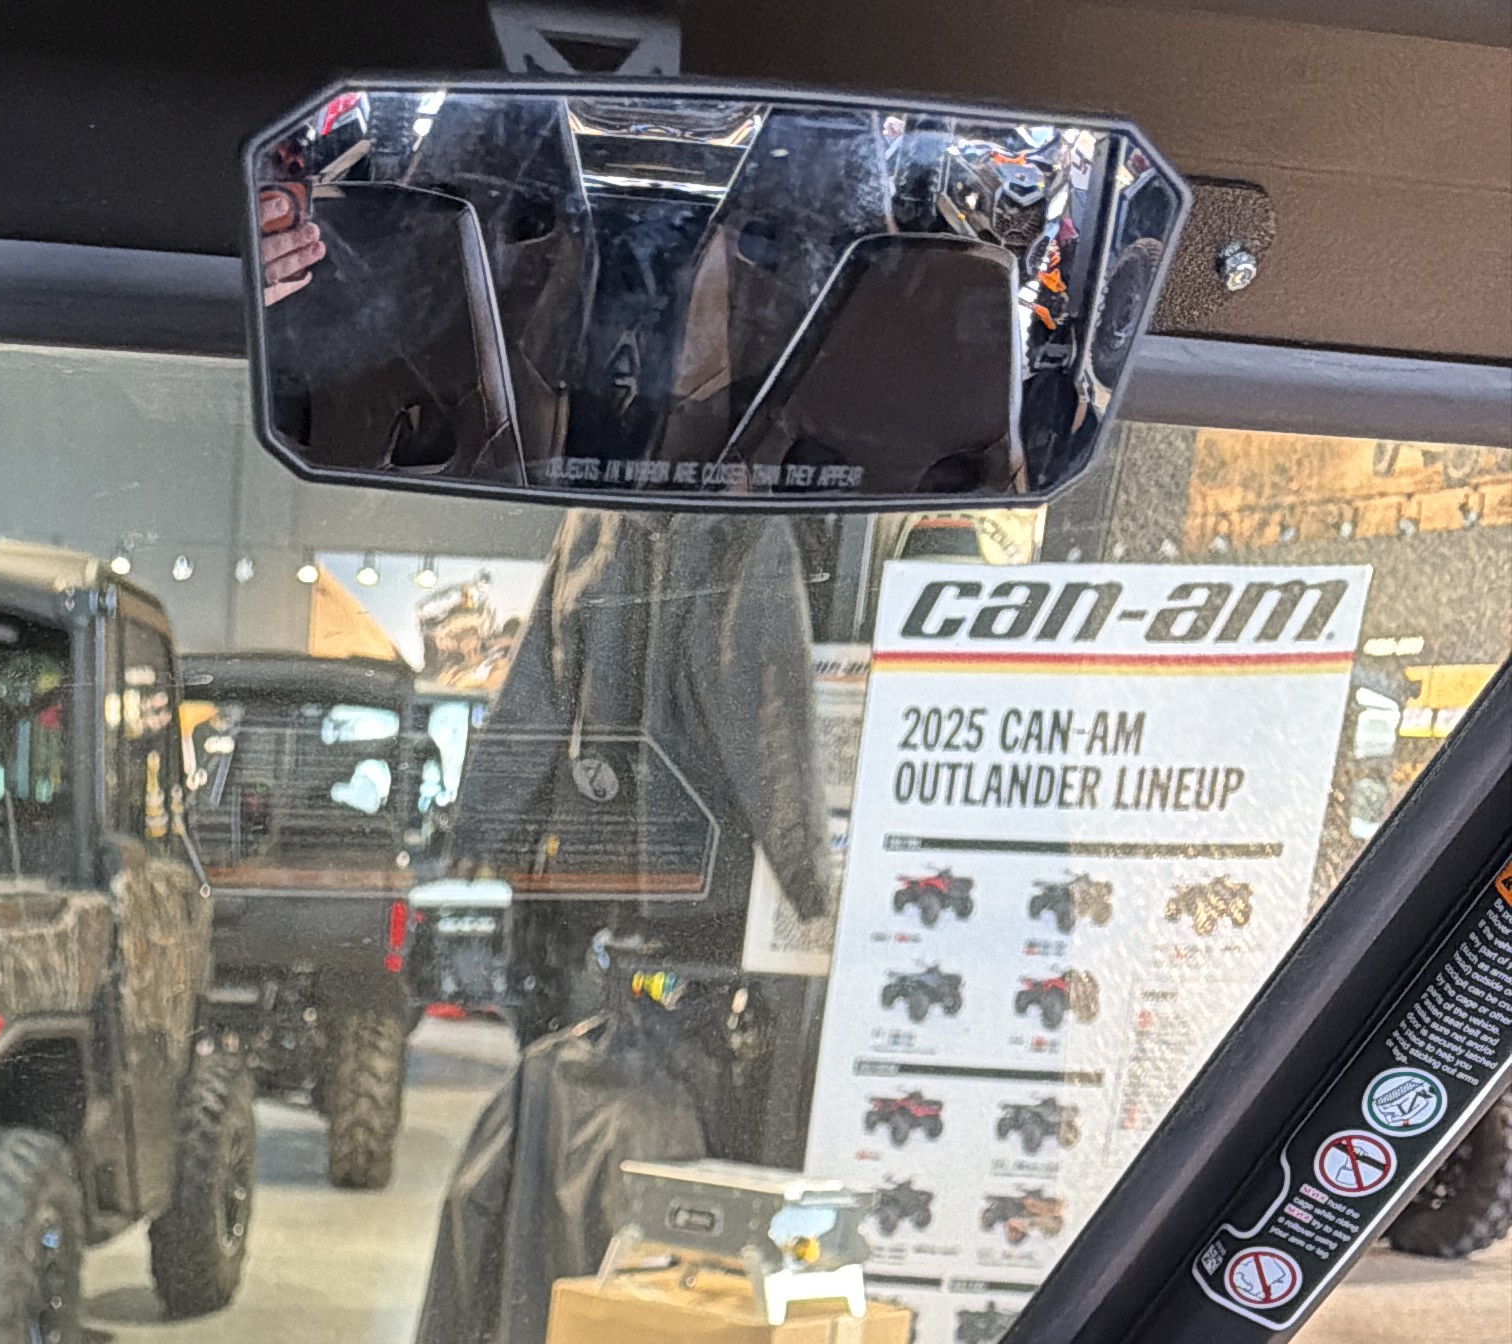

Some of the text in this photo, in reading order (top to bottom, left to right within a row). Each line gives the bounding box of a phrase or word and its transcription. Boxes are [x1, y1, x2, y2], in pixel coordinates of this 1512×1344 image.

[899, 579, 1348, 643] can-am
[898, 705, 1147, 755] 2025 CAN-AM
[894, 760, 1245, 811] OUTLANDER LINEUP
